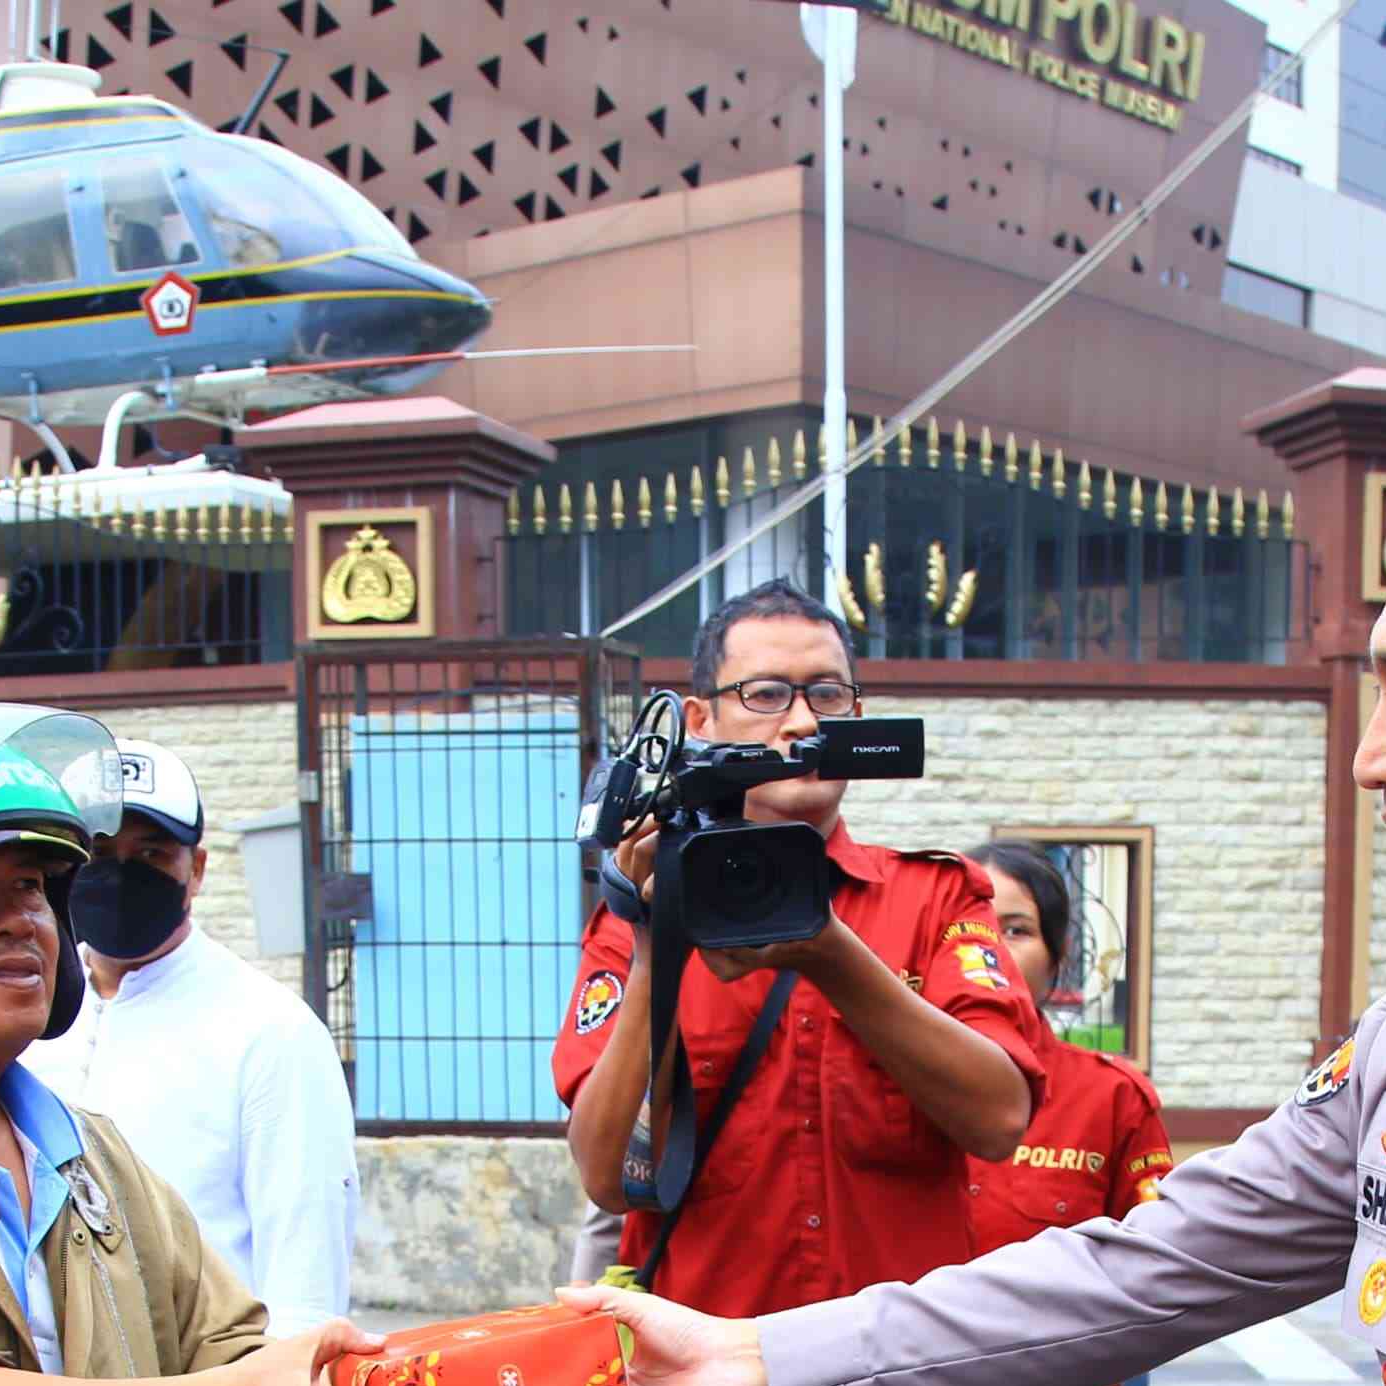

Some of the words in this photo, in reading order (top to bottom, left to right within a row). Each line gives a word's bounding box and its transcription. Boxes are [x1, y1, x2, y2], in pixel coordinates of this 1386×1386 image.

[912, 2, 1024, 72] NATIONAL
[1028, 49, 1101, 99] POLICE
[1103, 78, 1184, 133] MUSEUM
[1041, 0, 1206, 98] POLRI
[1012, 1144, 1085, 1171] POLRI
